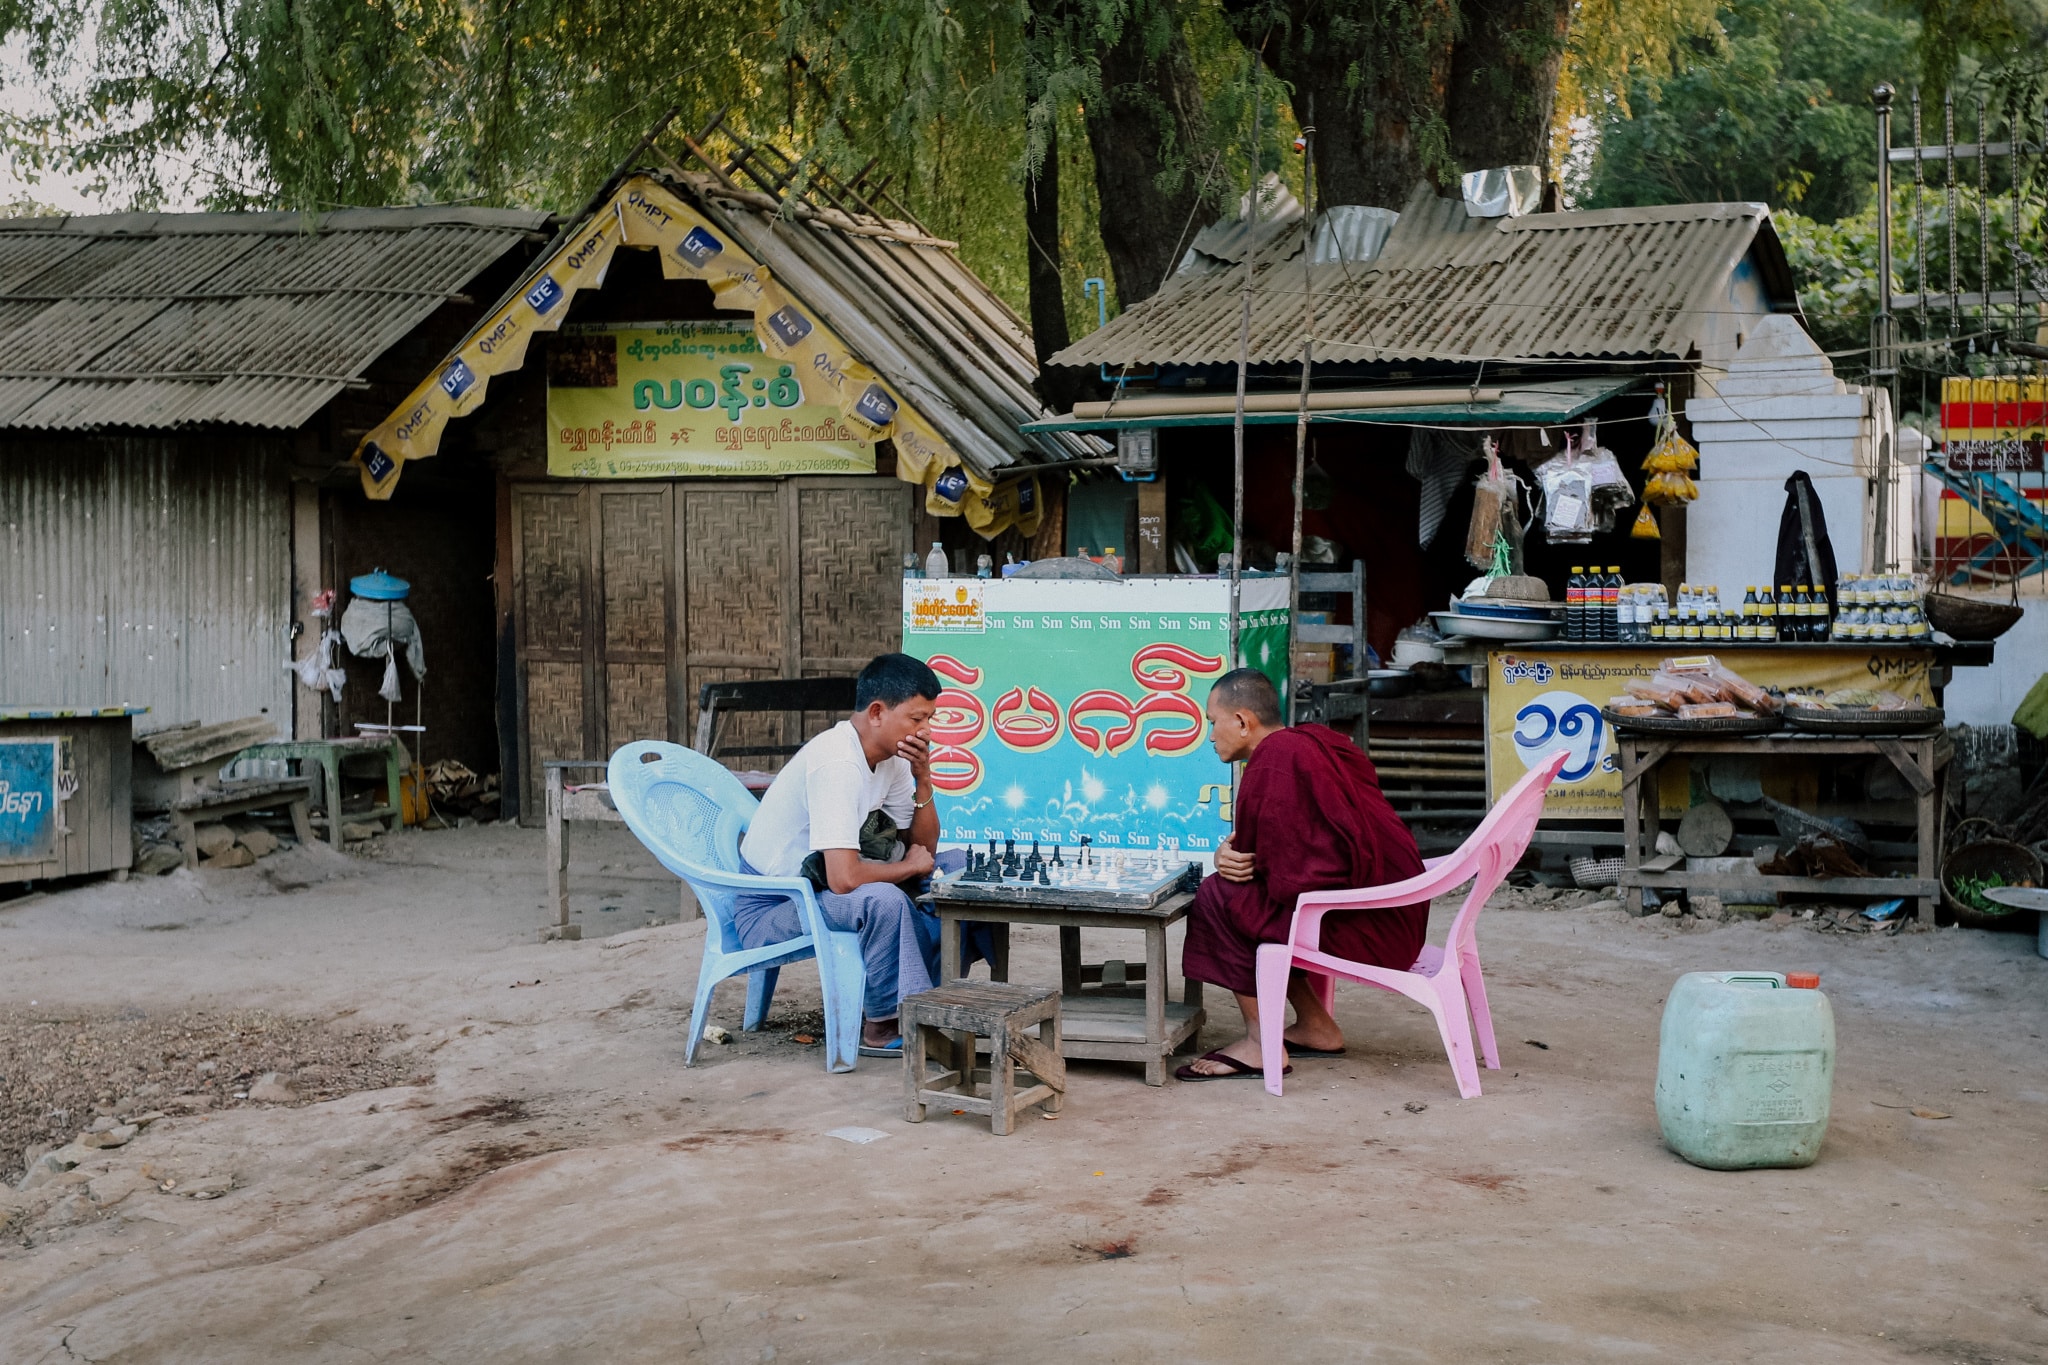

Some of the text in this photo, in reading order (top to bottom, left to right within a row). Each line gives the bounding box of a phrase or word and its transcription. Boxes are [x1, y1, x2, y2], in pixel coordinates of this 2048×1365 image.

[779, 459, 850, 471] 09-257688909
[985, 616, 1006, 630] Sm
[1013, 616, 1034, 630] Sm
[1042, 616, 1063, 630] Sm
[1071, 616, 1092, 630] Sm
[1100, 616, 1121, 630] Sm
[1129, 616, 1151, 630] Sm
[1159, 616, 1181, 630] Sm
[1189, 616, 1211, 630] Sm
[956, 826, 976, 840] Sm
[984, 827, 1005, 840] Sm
[1012, 828, 1033, 841] Sm
[1040, 828, 1062, 842] Sm
[1099, 830, 1120, 844] Sm
[1128, 832, 1150, 846] Sm
[1158, 833, 1179, 847] Sm
[1187, 834, 1209, 848] Sm
